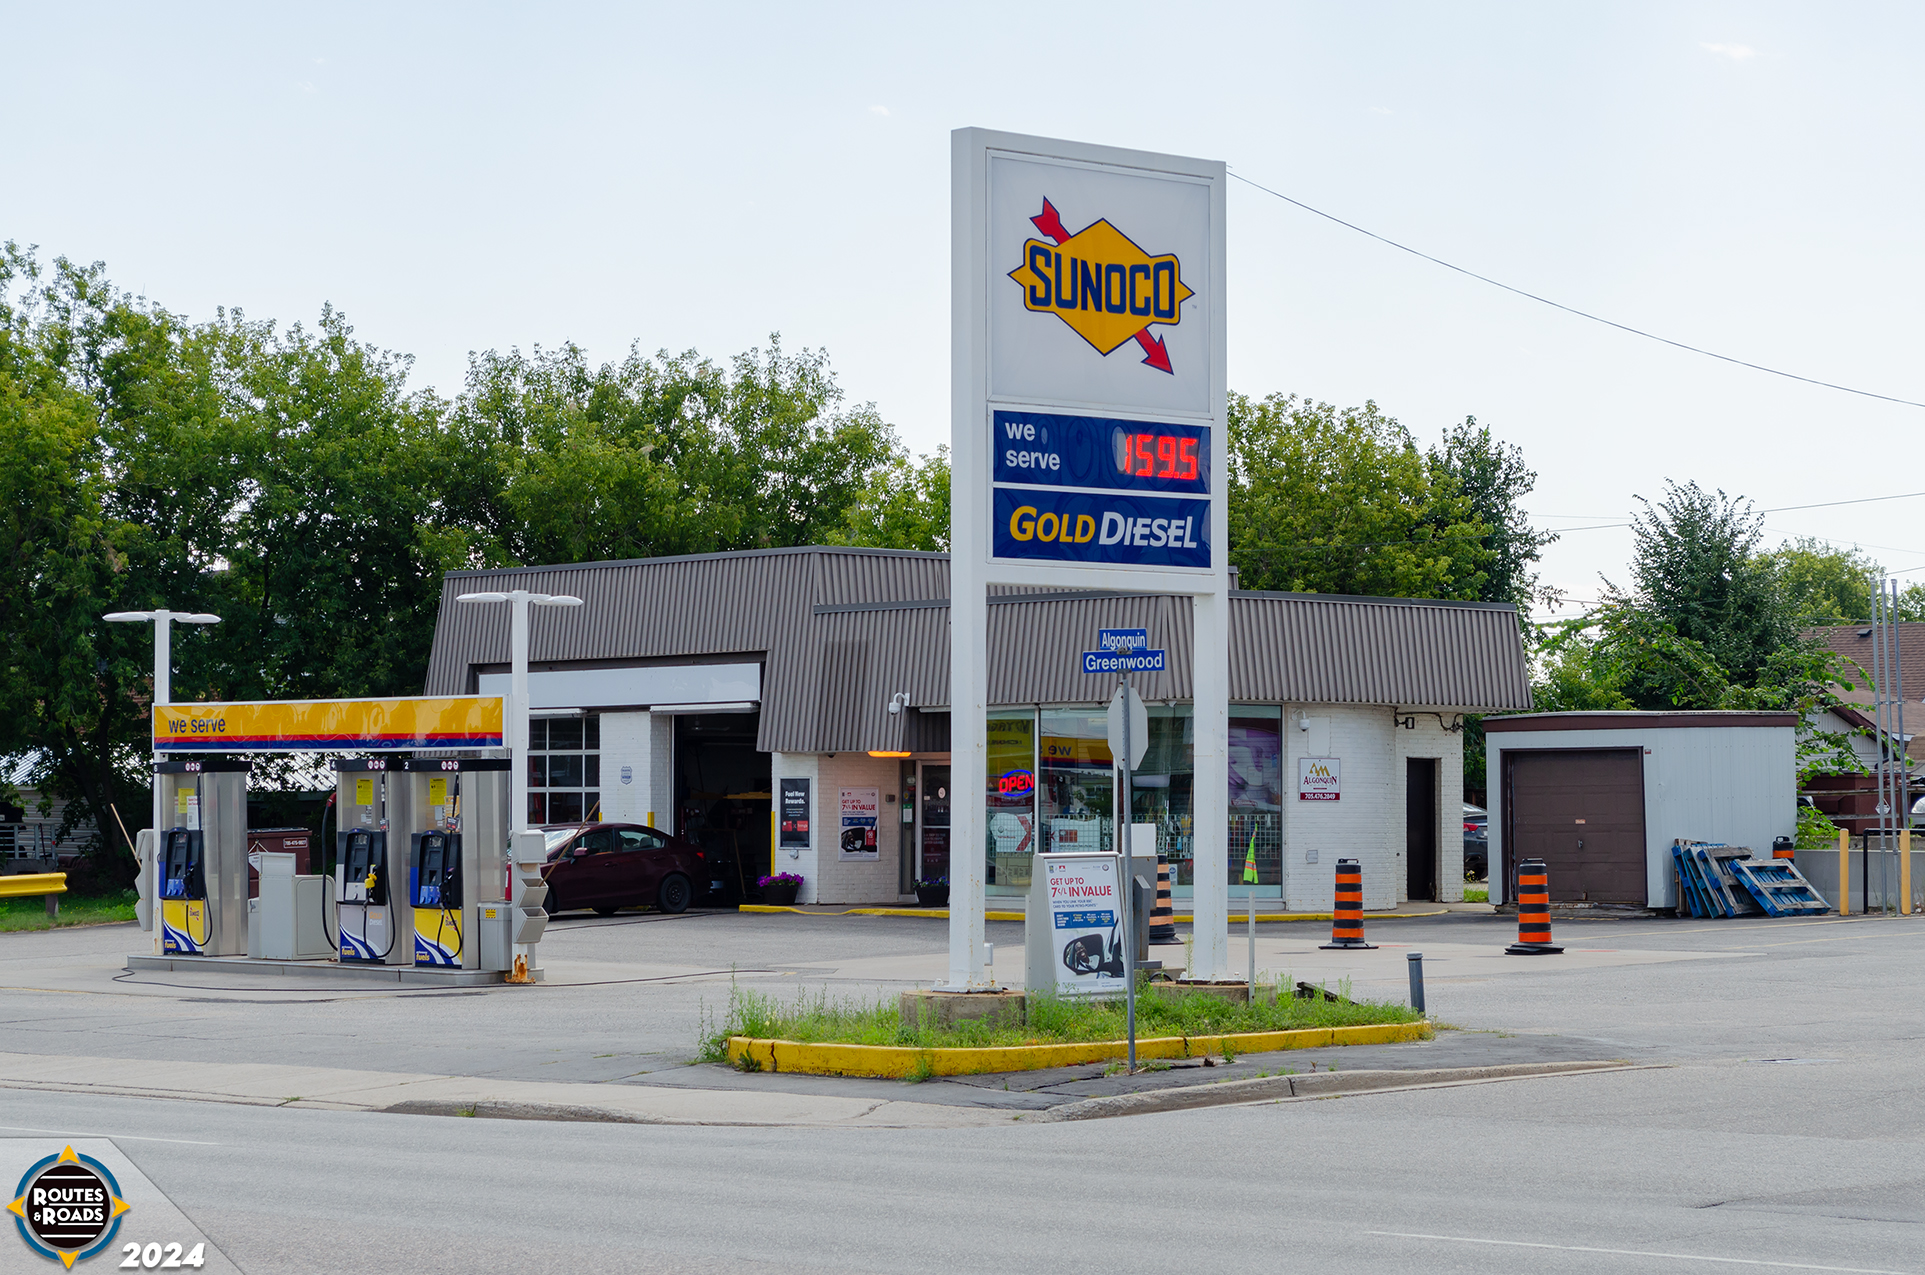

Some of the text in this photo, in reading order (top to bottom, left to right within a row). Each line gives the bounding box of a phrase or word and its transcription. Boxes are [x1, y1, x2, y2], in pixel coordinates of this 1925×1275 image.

[1029, 245, 1175, 319] SUNOCO
[1005, 422, 1036, 441] we
[1005, 449, 1061, 471] serve
[1124, 434, 1198, 480] 159.5
[1009, 505, 1198, 549] GOLD DIESEL
[1102, 632, 1146, 650] Algonquin
[1086, 653, 1162, 670] Greenwood
[168, 718, 226, 734] we serve
[999, 774, 1034, 793] OPEN
[1304, 776, 1338, 785] ALGONQUIN
[1069, 887, 1080, 897] IN
[1081, 886, 1111, 896] VALUE
